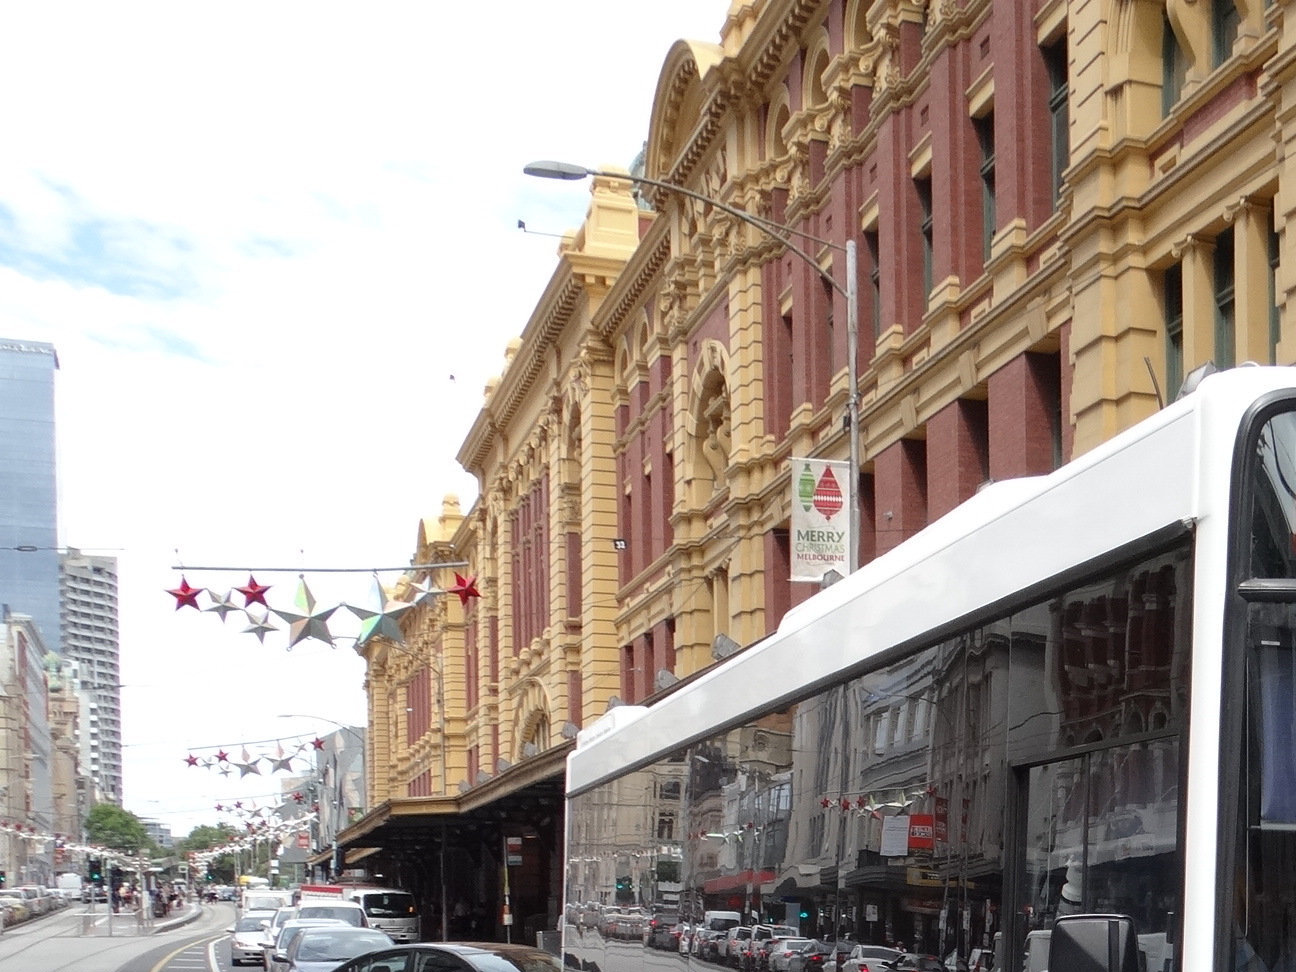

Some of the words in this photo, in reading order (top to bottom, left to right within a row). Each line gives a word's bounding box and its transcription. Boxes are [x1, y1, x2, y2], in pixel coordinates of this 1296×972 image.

[797, 529, 845, 543] MERRY
[795, 542, 845, 554] CHRISTMAS
[796, 553, 845, 561] MELBOURNE
